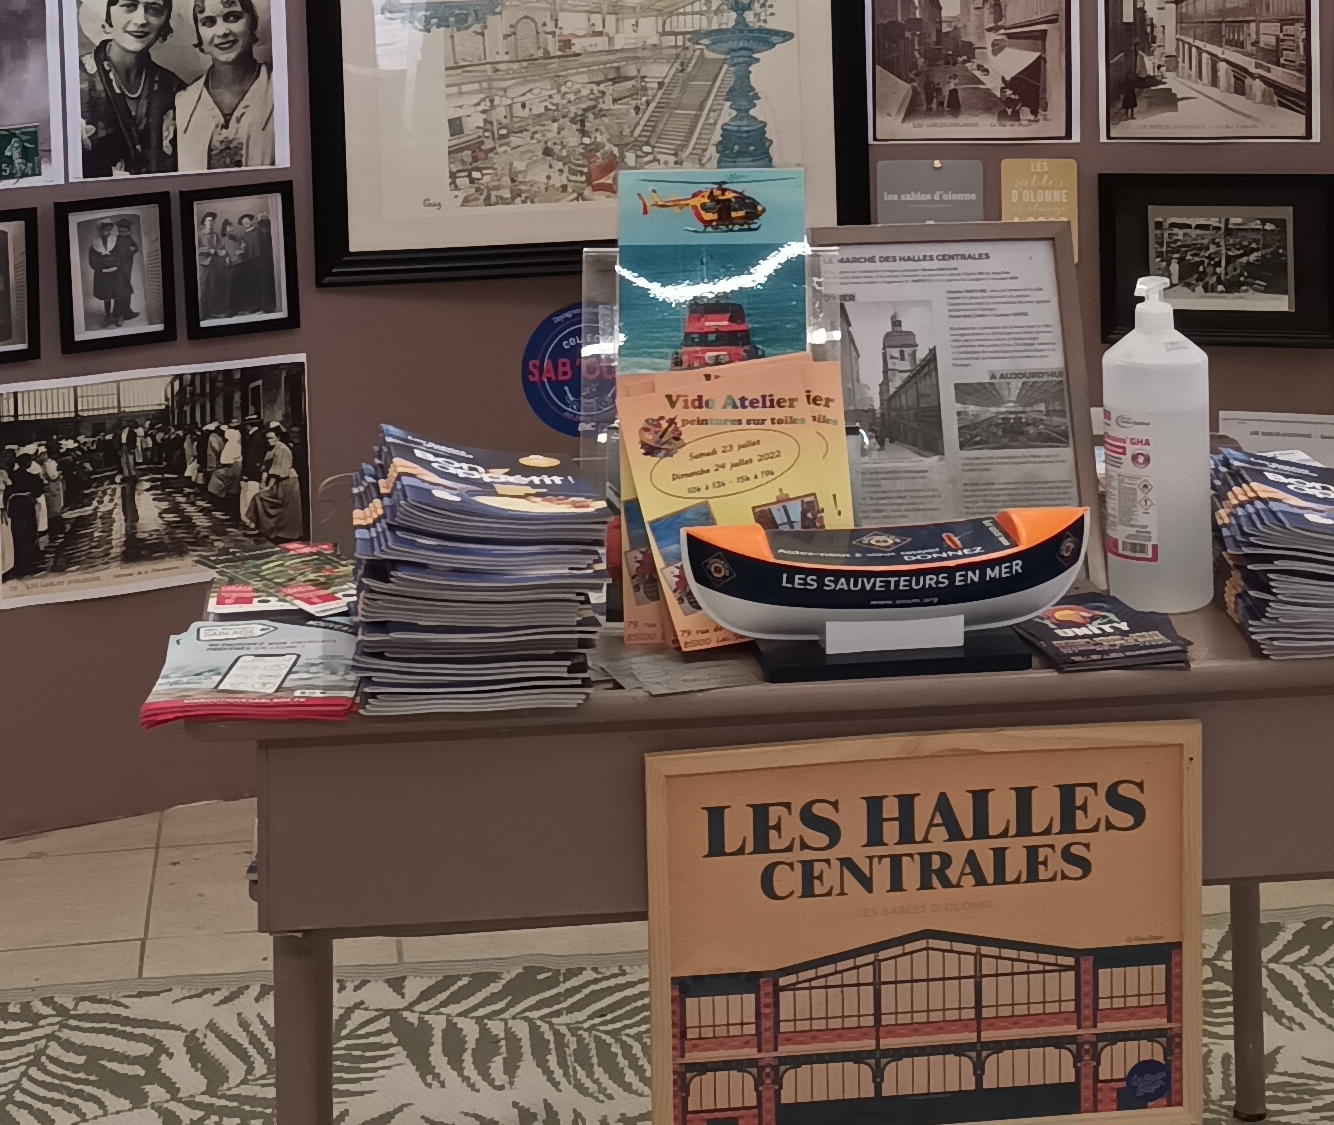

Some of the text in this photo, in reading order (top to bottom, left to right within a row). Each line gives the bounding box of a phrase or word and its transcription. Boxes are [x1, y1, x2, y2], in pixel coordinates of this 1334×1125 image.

[1030, 162, 1049, 173] LES
[1011, 188, 1068, 203] D'OLONNE
[879, 254, 897, 263] DES
[898, 253, 935, 263] HALLES
[935, 252, 991, 262] CENTRALES
[665, 393, 716, 410] Vide
[721, 393, 799, 410] Atelier
[770, 415, 806, 425] toiles
[721, 443, 734, 454] 23
[737, 439, 761, 452] juillet
[1130, 437, 1151, 447] GHA
[730, 457, 754, 470] juillet
[757, 449, 782, 463] 2022
[903, 546, 986, 562] DONNEZ
[781, 559, 1024, 592] LES SAUVETEURS EN MER
[679, 629, 691, 637] 79
[700, 778, 1147, 859] LES HALLES
[759, 840, 1093, 902] CENTRALES
[856, 899, 996, 919] LES SABLES D'OLONNE
